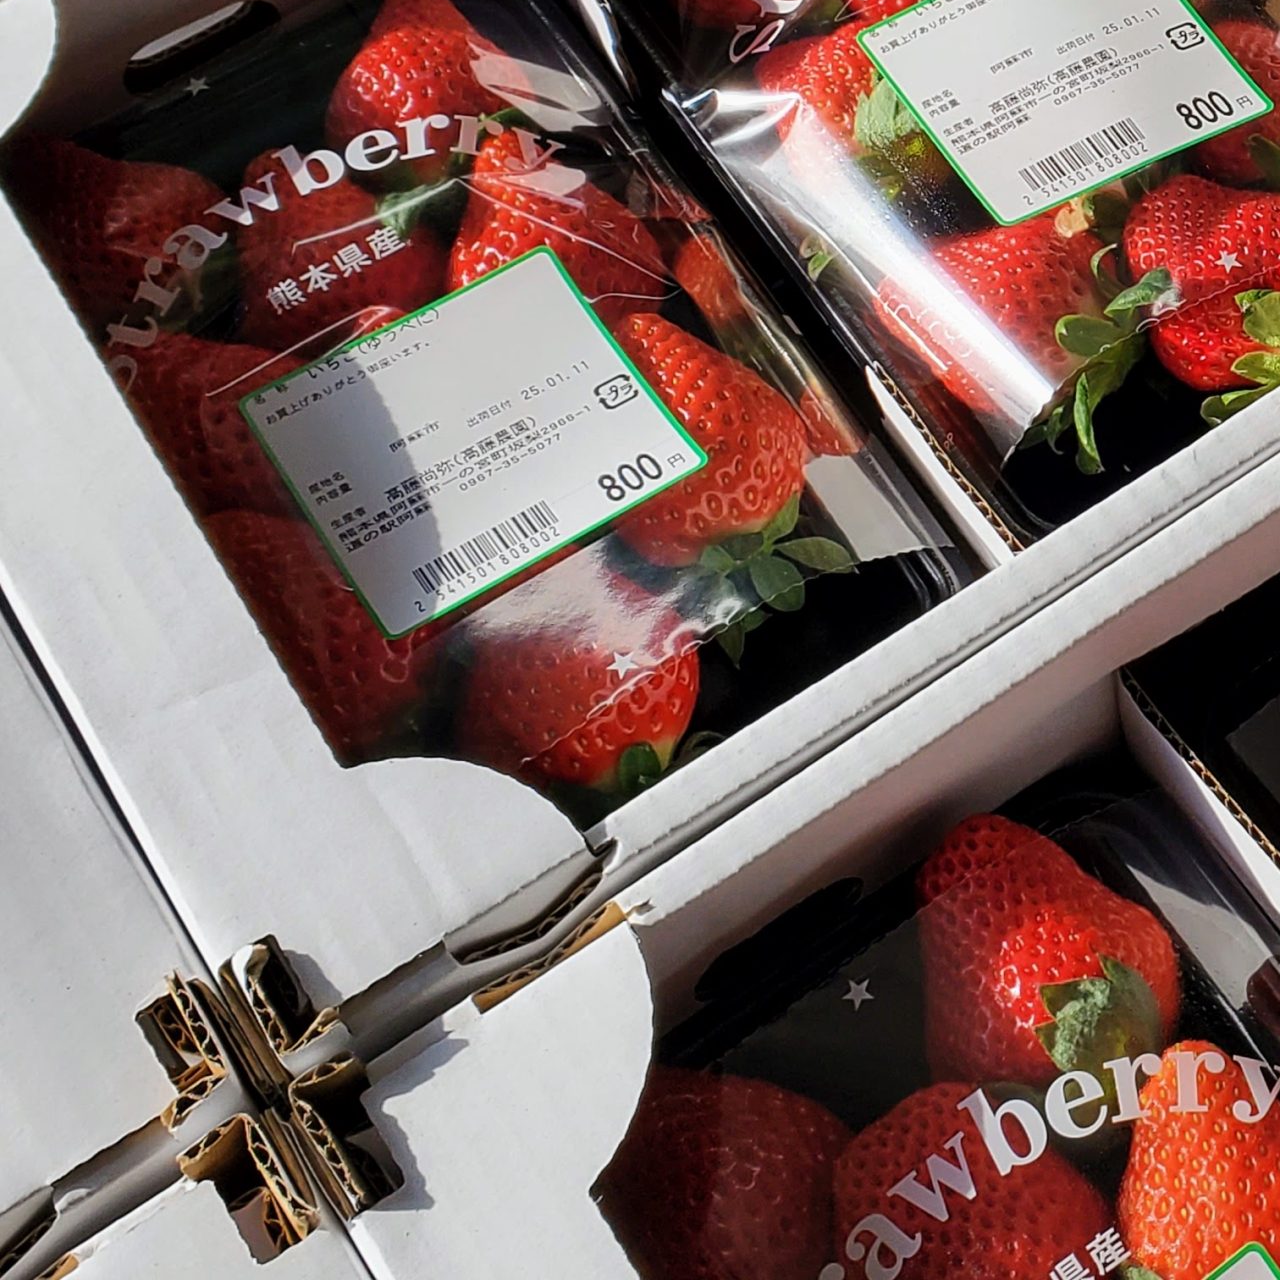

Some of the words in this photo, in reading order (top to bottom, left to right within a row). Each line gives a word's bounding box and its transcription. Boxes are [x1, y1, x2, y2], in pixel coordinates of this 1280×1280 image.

[921, 89, 953, 109] 産地名
[990, 48, 1032, 74] 阿蘇市
[929, 99, 960, 118] 内容量
[1057, 33, 1095, 55] 出荷日付
[1054, 63, 1139, 105] 0967-35-5077
[943, 118, 974, 137] 生産者
[1176, 91, 1234, 129] 800
[265, 223, 407, 315] 熊本県産
[316, 483, 352, 505] 内容量
[467, 400, 511, 428] 出荷日付
[308, 472, 345, 494] 産地名
[345, 501, 432, 553] 道の駅阿蘇
[459, 433, 560, 491] 0967-35-5077
[598, 454, 663, 501] 800
[331, 507, 366, 530] 生産者
